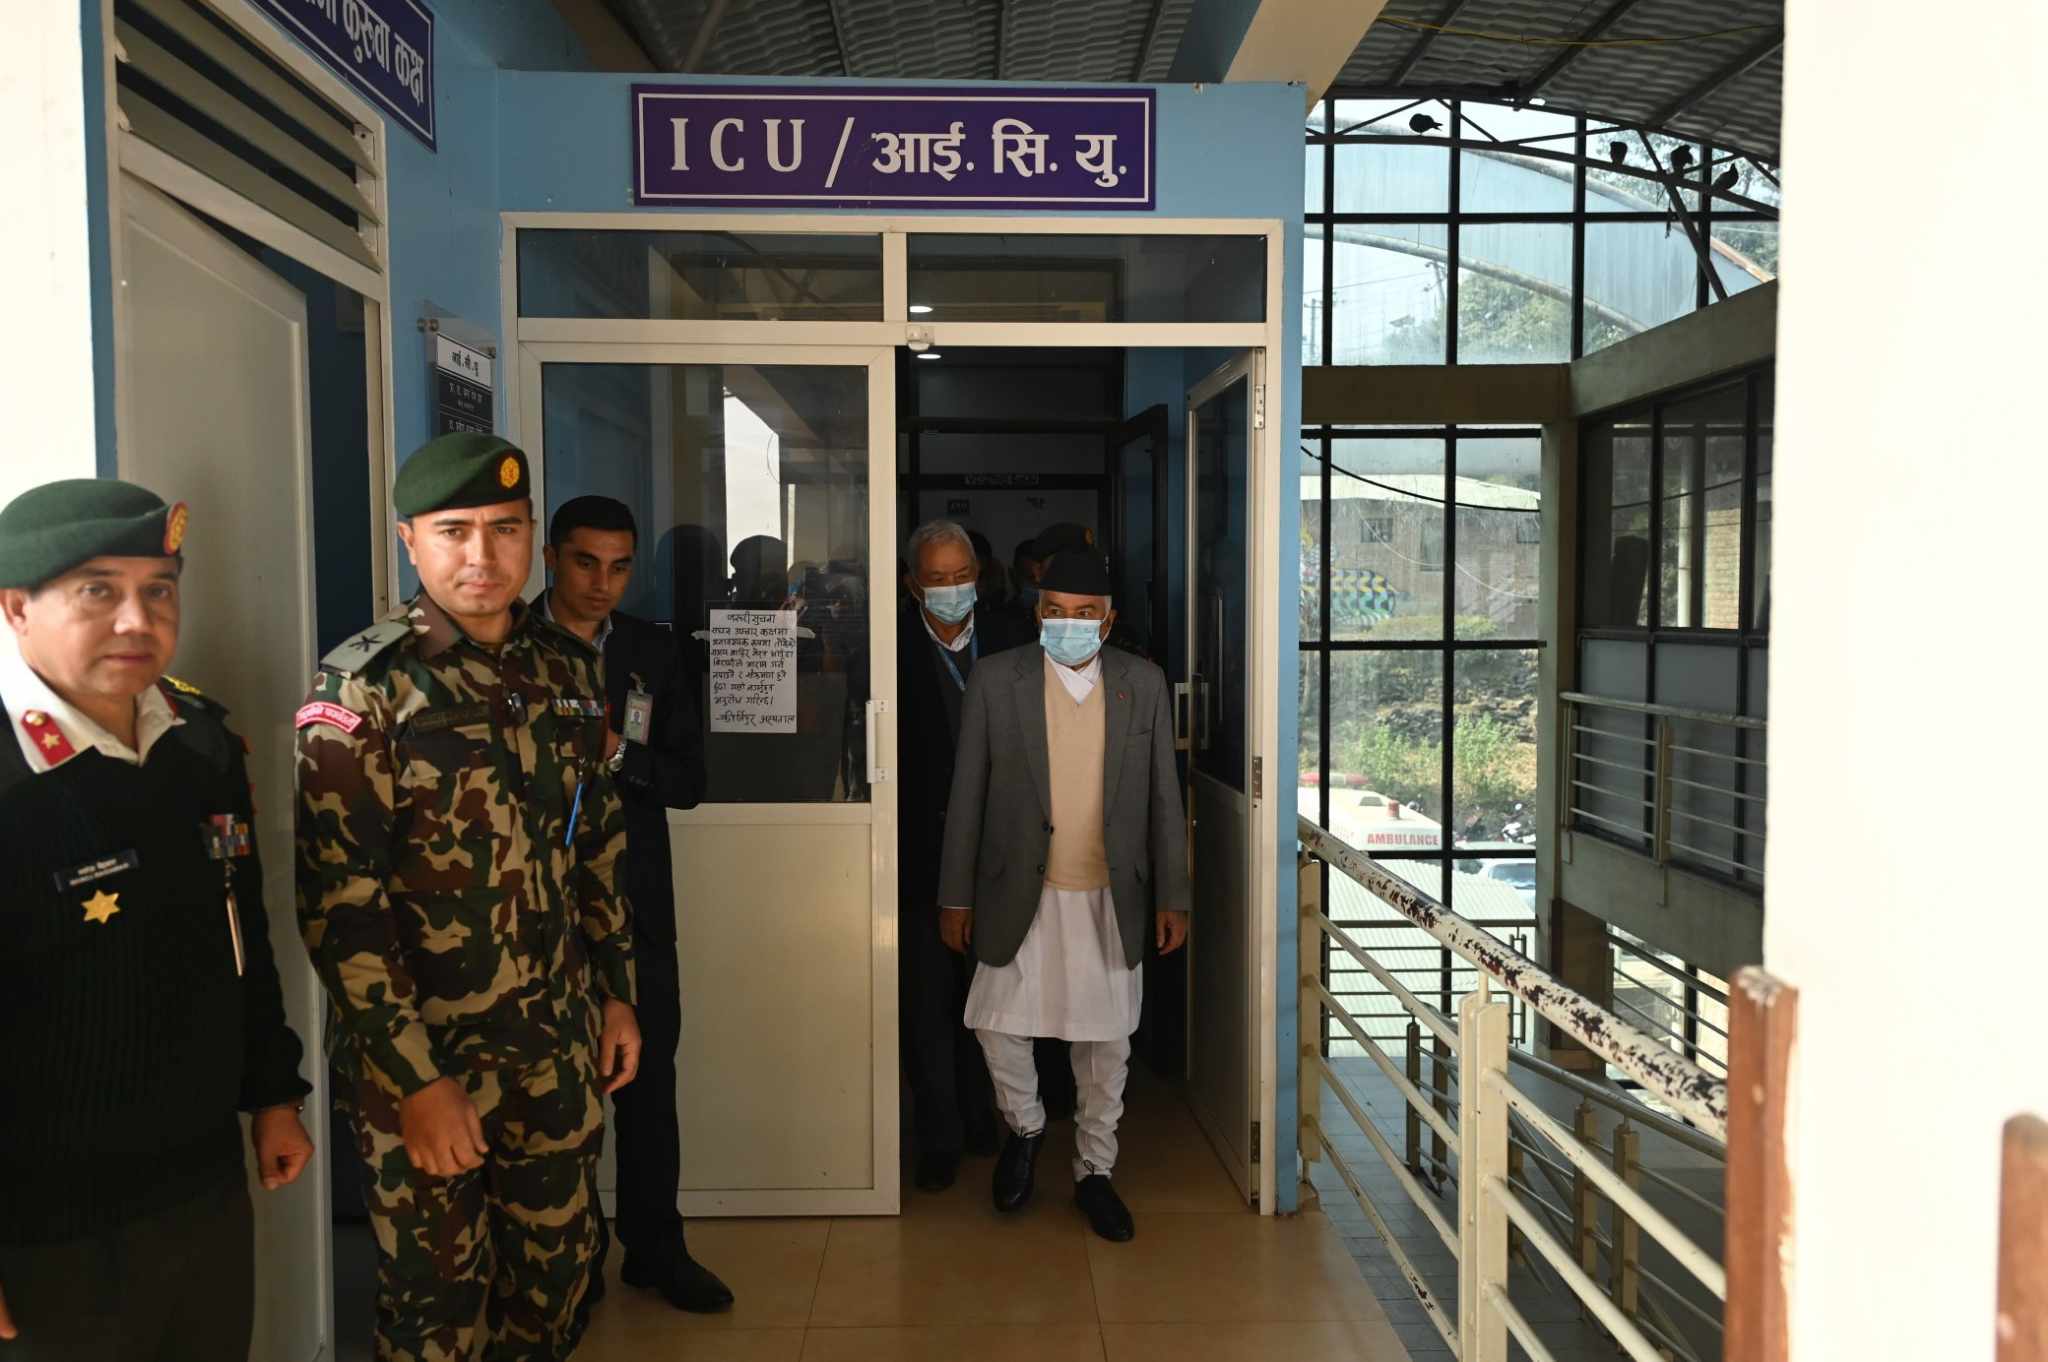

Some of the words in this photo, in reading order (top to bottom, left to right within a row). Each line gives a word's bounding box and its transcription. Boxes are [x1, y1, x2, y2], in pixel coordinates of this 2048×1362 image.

[394, 32, 425, 108] कक्ष
[669, 117, 807, 173] ICU
[871, 121, 975, 181] आई.
[992, 118, 1058, 178] सि.
[1075, 134, 1128, 188] यु.
[1367, 833, 1439, 846] AMBULANCE
